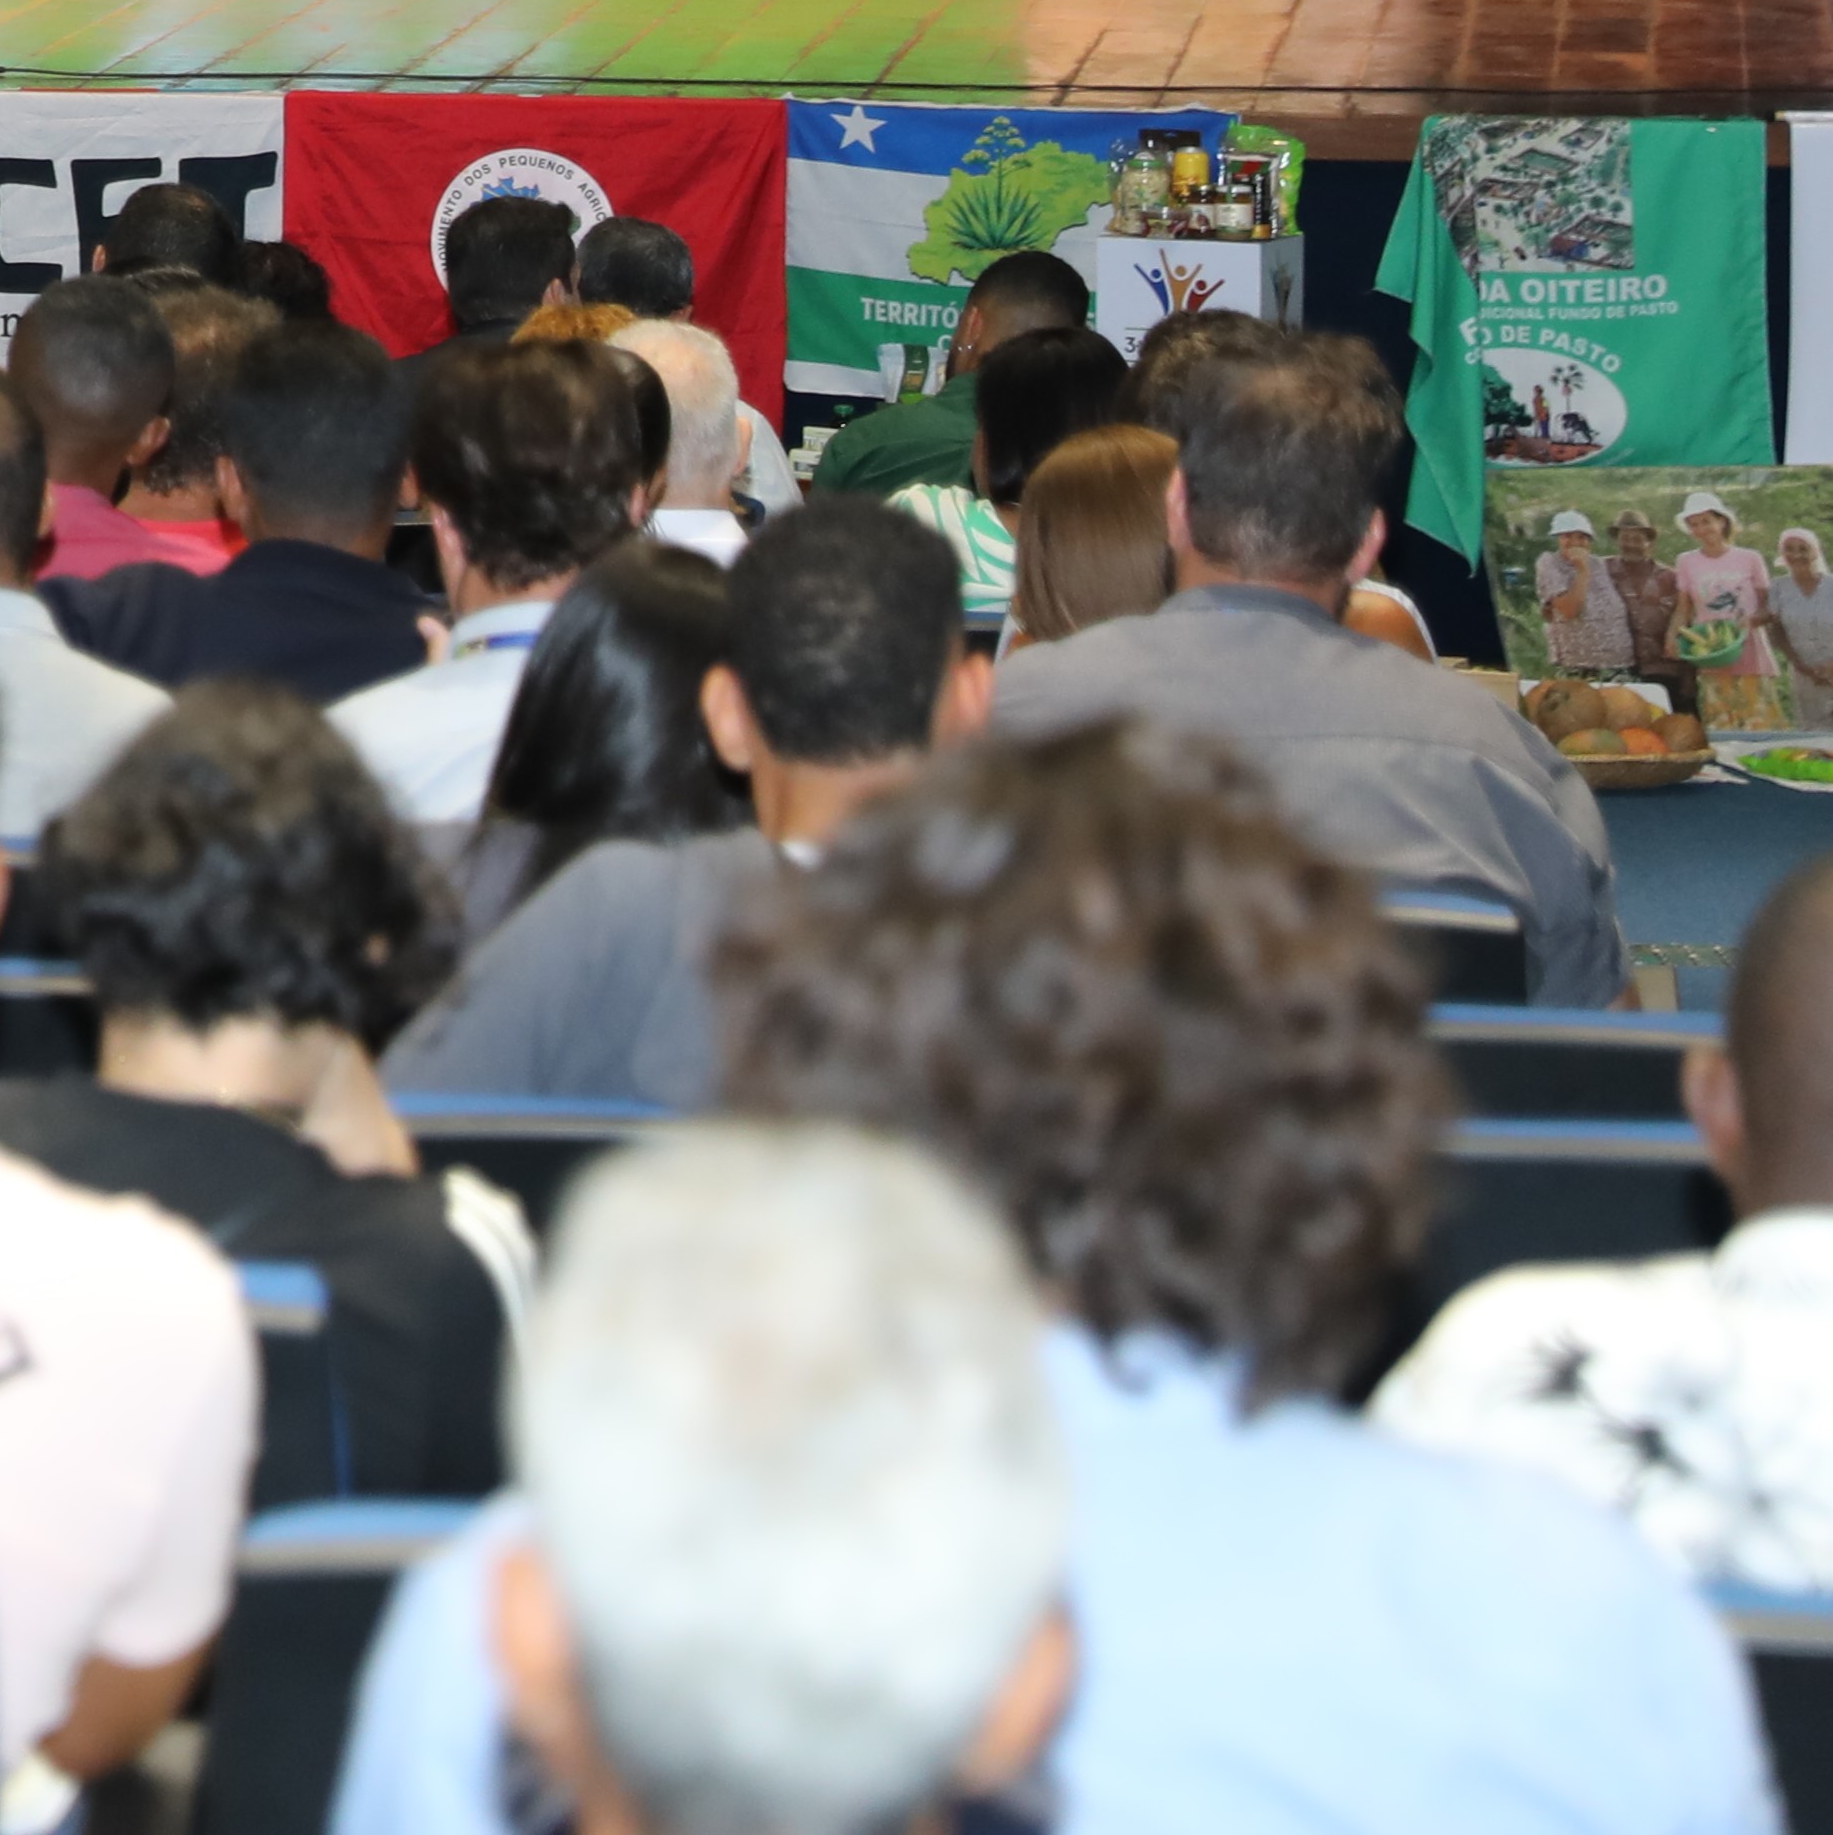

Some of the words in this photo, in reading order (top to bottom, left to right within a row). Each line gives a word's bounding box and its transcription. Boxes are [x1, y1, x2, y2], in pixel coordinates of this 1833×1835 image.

[464, 163, 491, 187] DOS
[498, 155, 575, 181] PEQUENOS
[1519, 274, 1668, 304] OITEIRO
[860, 294, 960, 328] TERRITÓ
[1629, 300, 1679, 317] PASTO
[1499, 324, 1532, 344] DE
[1539, 327, 1622, 374] PASTO
